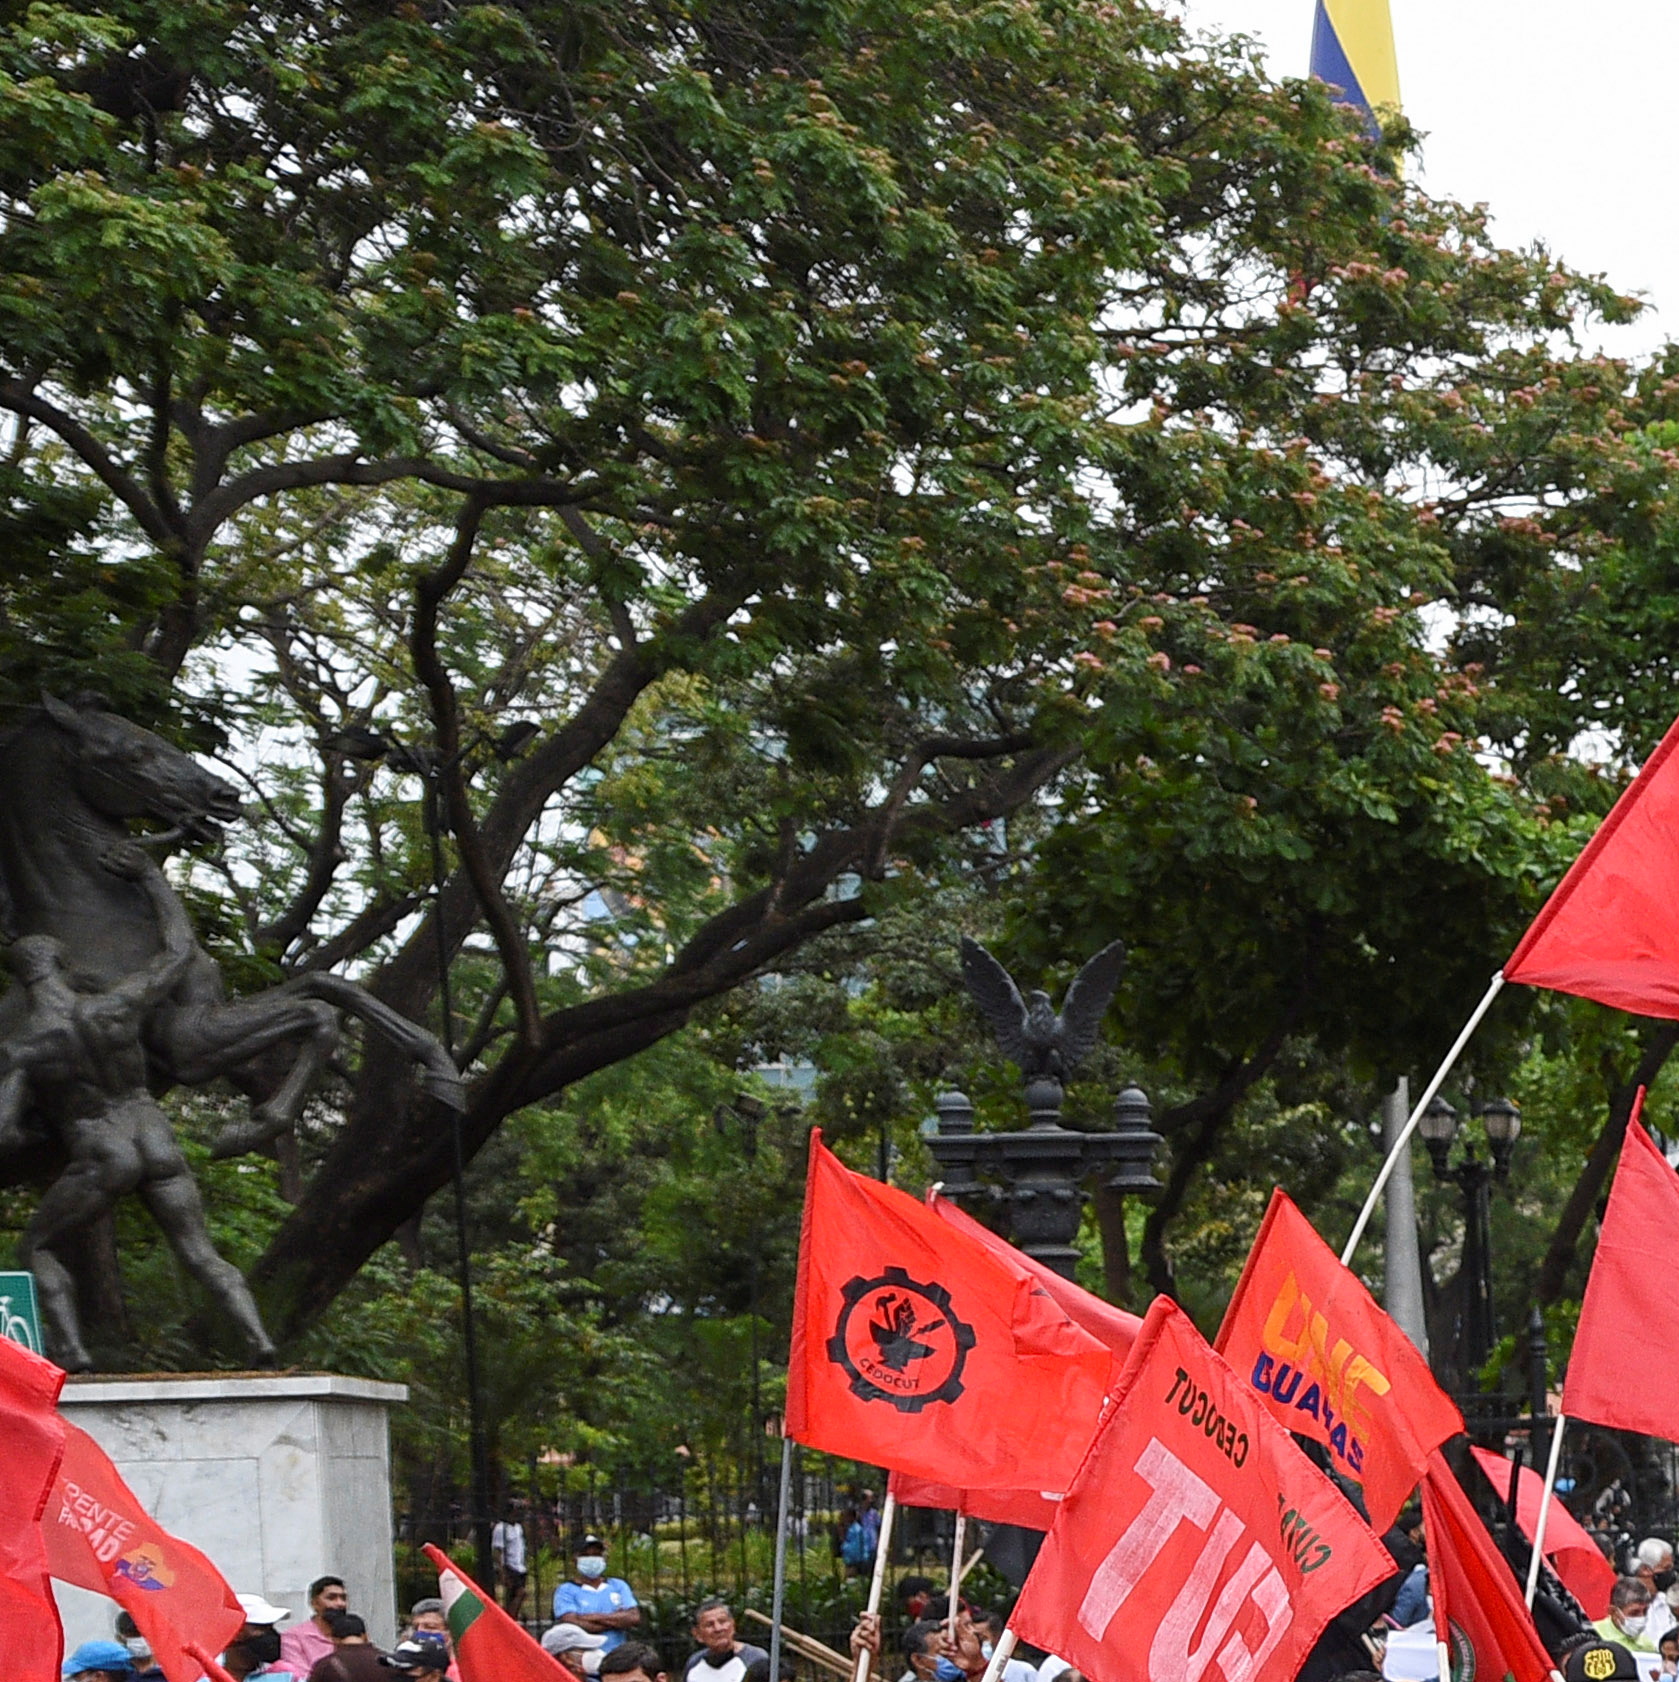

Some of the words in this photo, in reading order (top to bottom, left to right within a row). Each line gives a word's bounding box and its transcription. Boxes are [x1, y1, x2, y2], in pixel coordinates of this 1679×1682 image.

[858, 1357, 920, 1390] CEDOCUT
[1263, 1268, 1392, 1446] UNE
[1251, 1351, 1366, 1474] GUAYAS
[62, 1480, 137, 1542] RENTE
